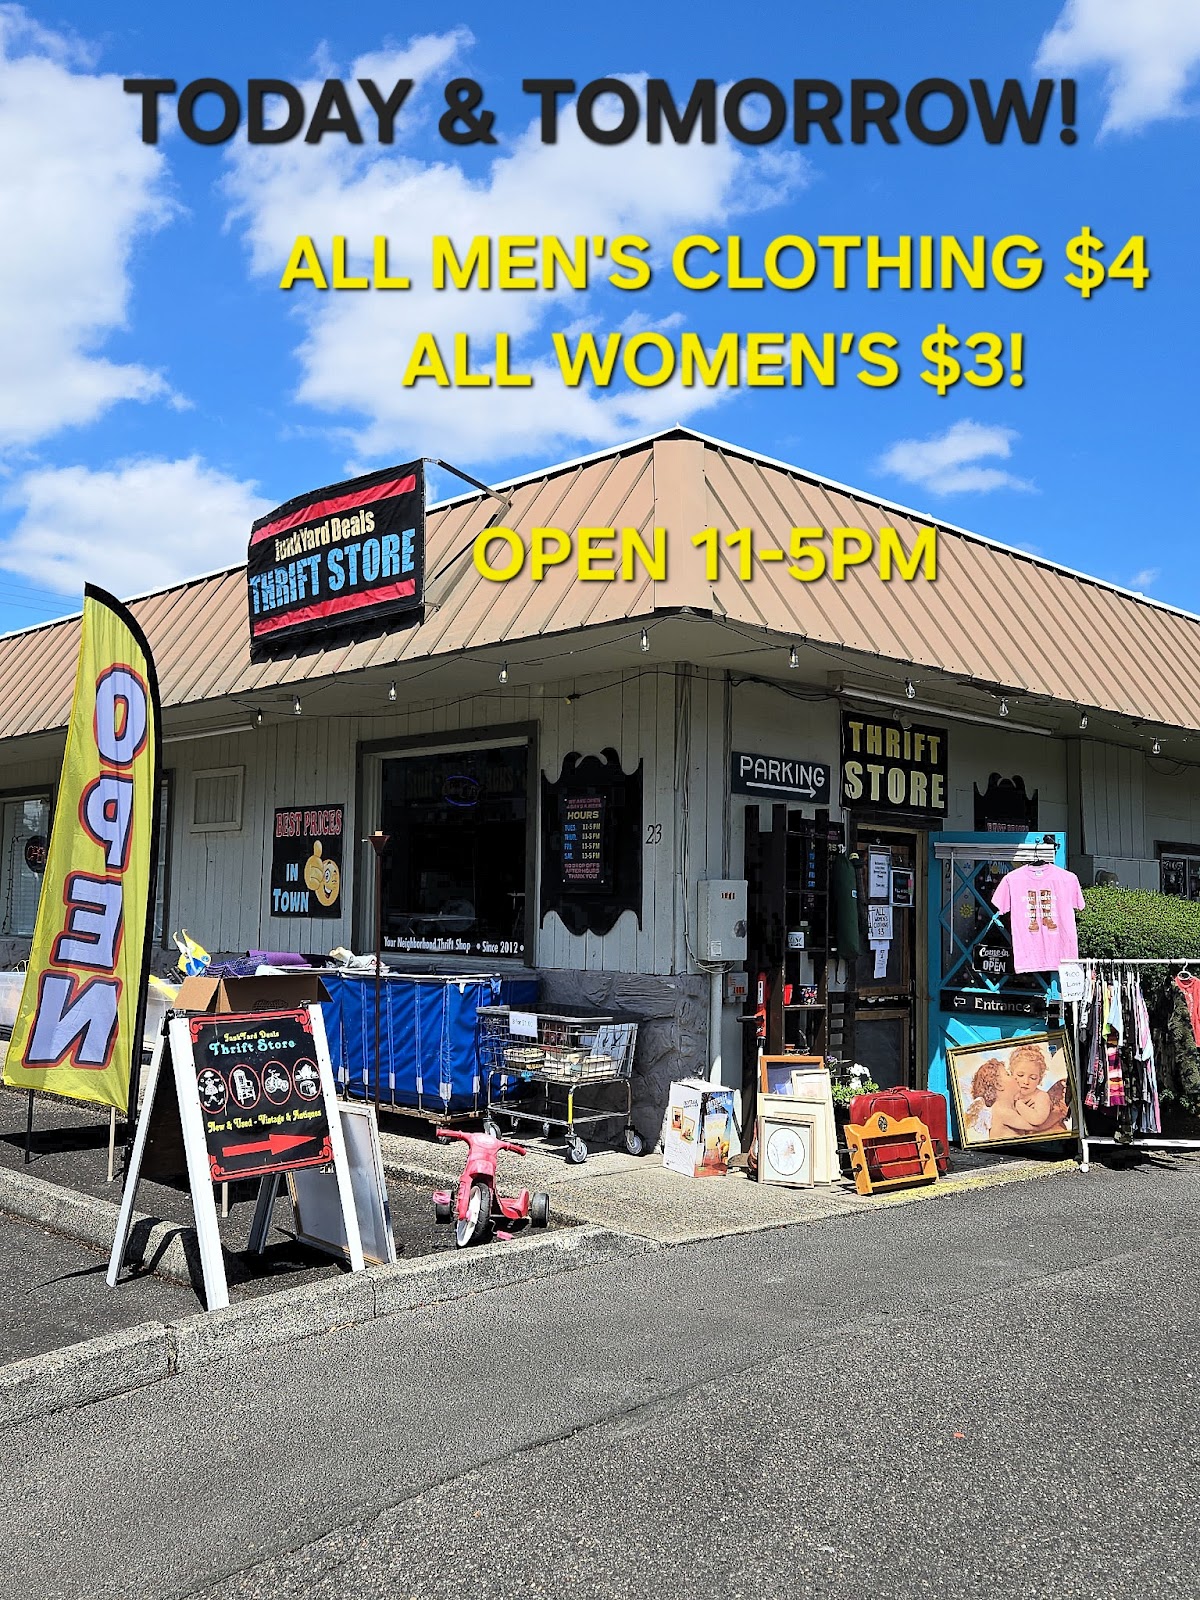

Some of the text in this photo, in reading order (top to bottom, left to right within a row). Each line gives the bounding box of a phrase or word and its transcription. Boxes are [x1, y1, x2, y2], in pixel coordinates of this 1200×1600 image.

[275, 509, 375, 562] JunkYard Deals
[250, 528, 416, 614] THRIFT STORE
[849, 721, 940, 764] THRIFT
[739, 755, 825, 787] PARKING
[844, 761, 945, 809] STORE
[275, 809, 342, 837] BEST PRICES
[567, 811, 599, 820] HOURS
[645, 823, 662, 844] 23
[285, 863, 299, 882] IN
[273, 888, 310, 913] TOWN
[875, 908, 886, 916] ALL
[384, 936, 518, 954] Your Neighborhood Thrift Shop Since 2012
[982, 960, 1006, 973] OPEN
[974, 997, 1031, 1013] Entrance
[259, 1030, 280, 1039] Deals
[208, 1038, 297, 1056] Thrift Store
[207, 1121, 226, 1134] New
[233, 1117, 253, 1130] Used
[258, 1113, 285, 1126] Vintage
[292, 1109, 322, 1122] Antiques
